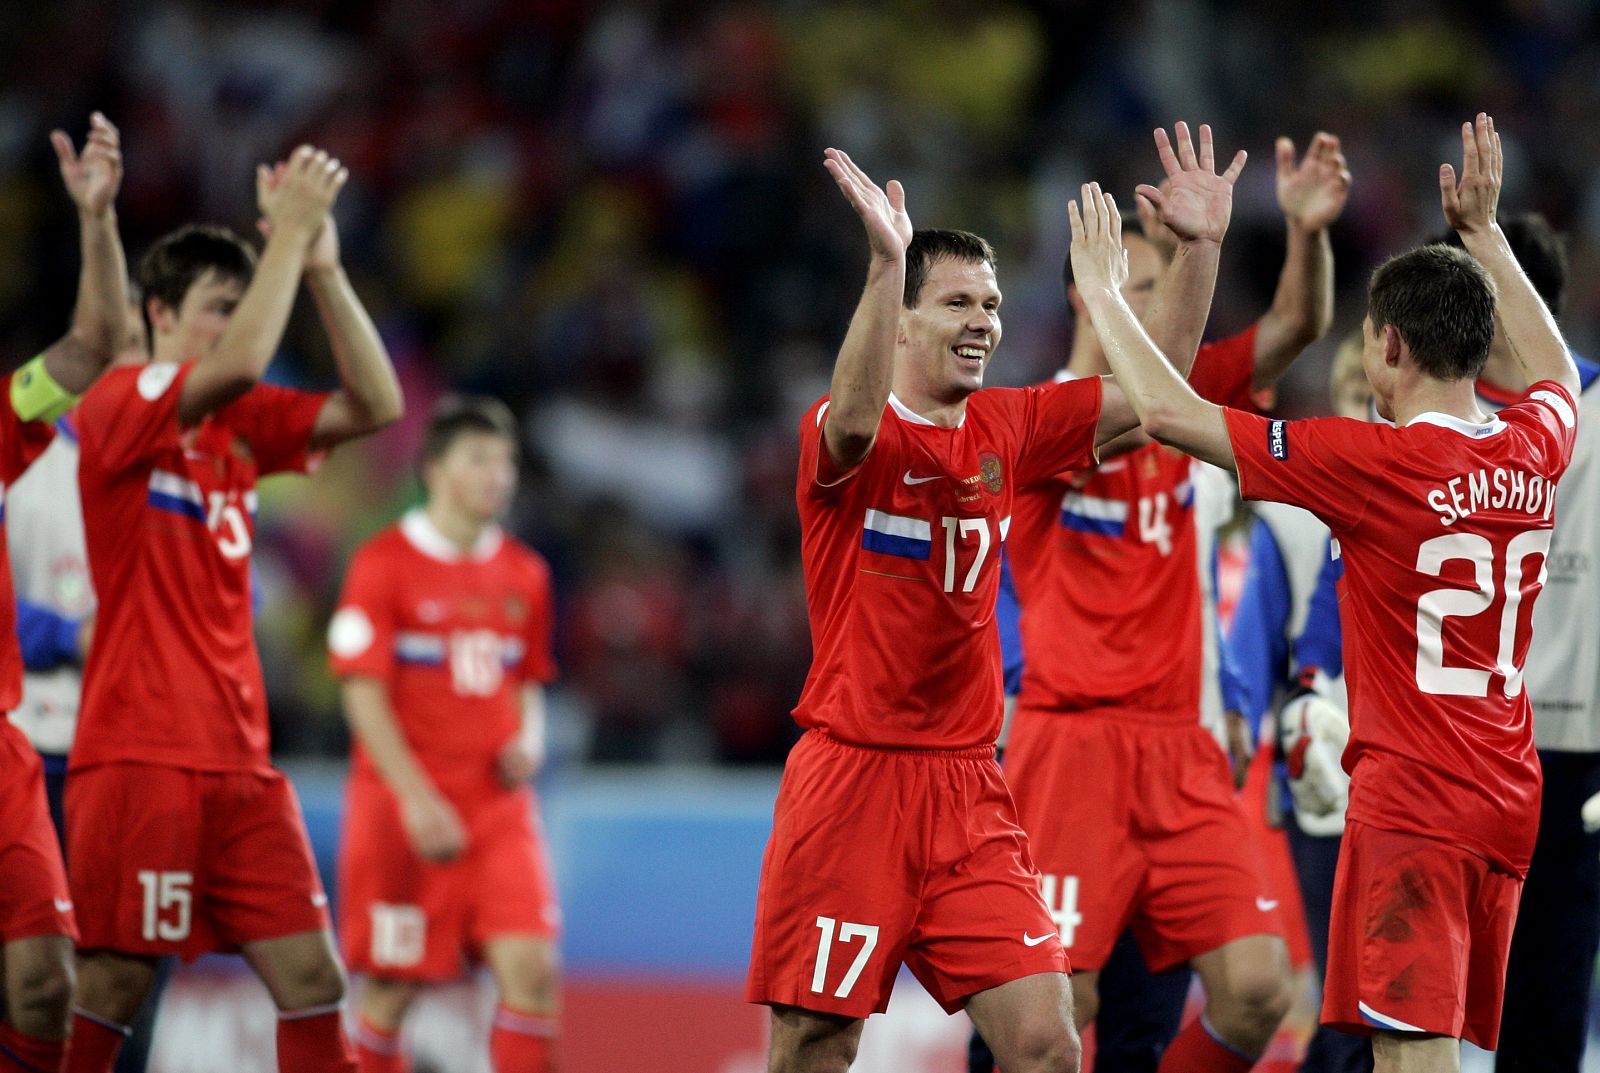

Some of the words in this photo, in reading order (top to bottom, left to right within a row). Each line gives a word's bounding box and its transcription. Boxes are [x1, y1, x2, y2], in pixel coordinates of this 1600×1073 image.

[207, 489, 252, 559] 15
[1138, 492, 1173, 556] 4
[1427, 467, 1556, 526] SEMSHOV
[942, 516, 990, 592] 17
[1415, 529, 1554, 697] 20
[138, 870, 193, 941] 15
[1042, 873, 1083, 948] 4
[811, 916, 880, 998] 17
